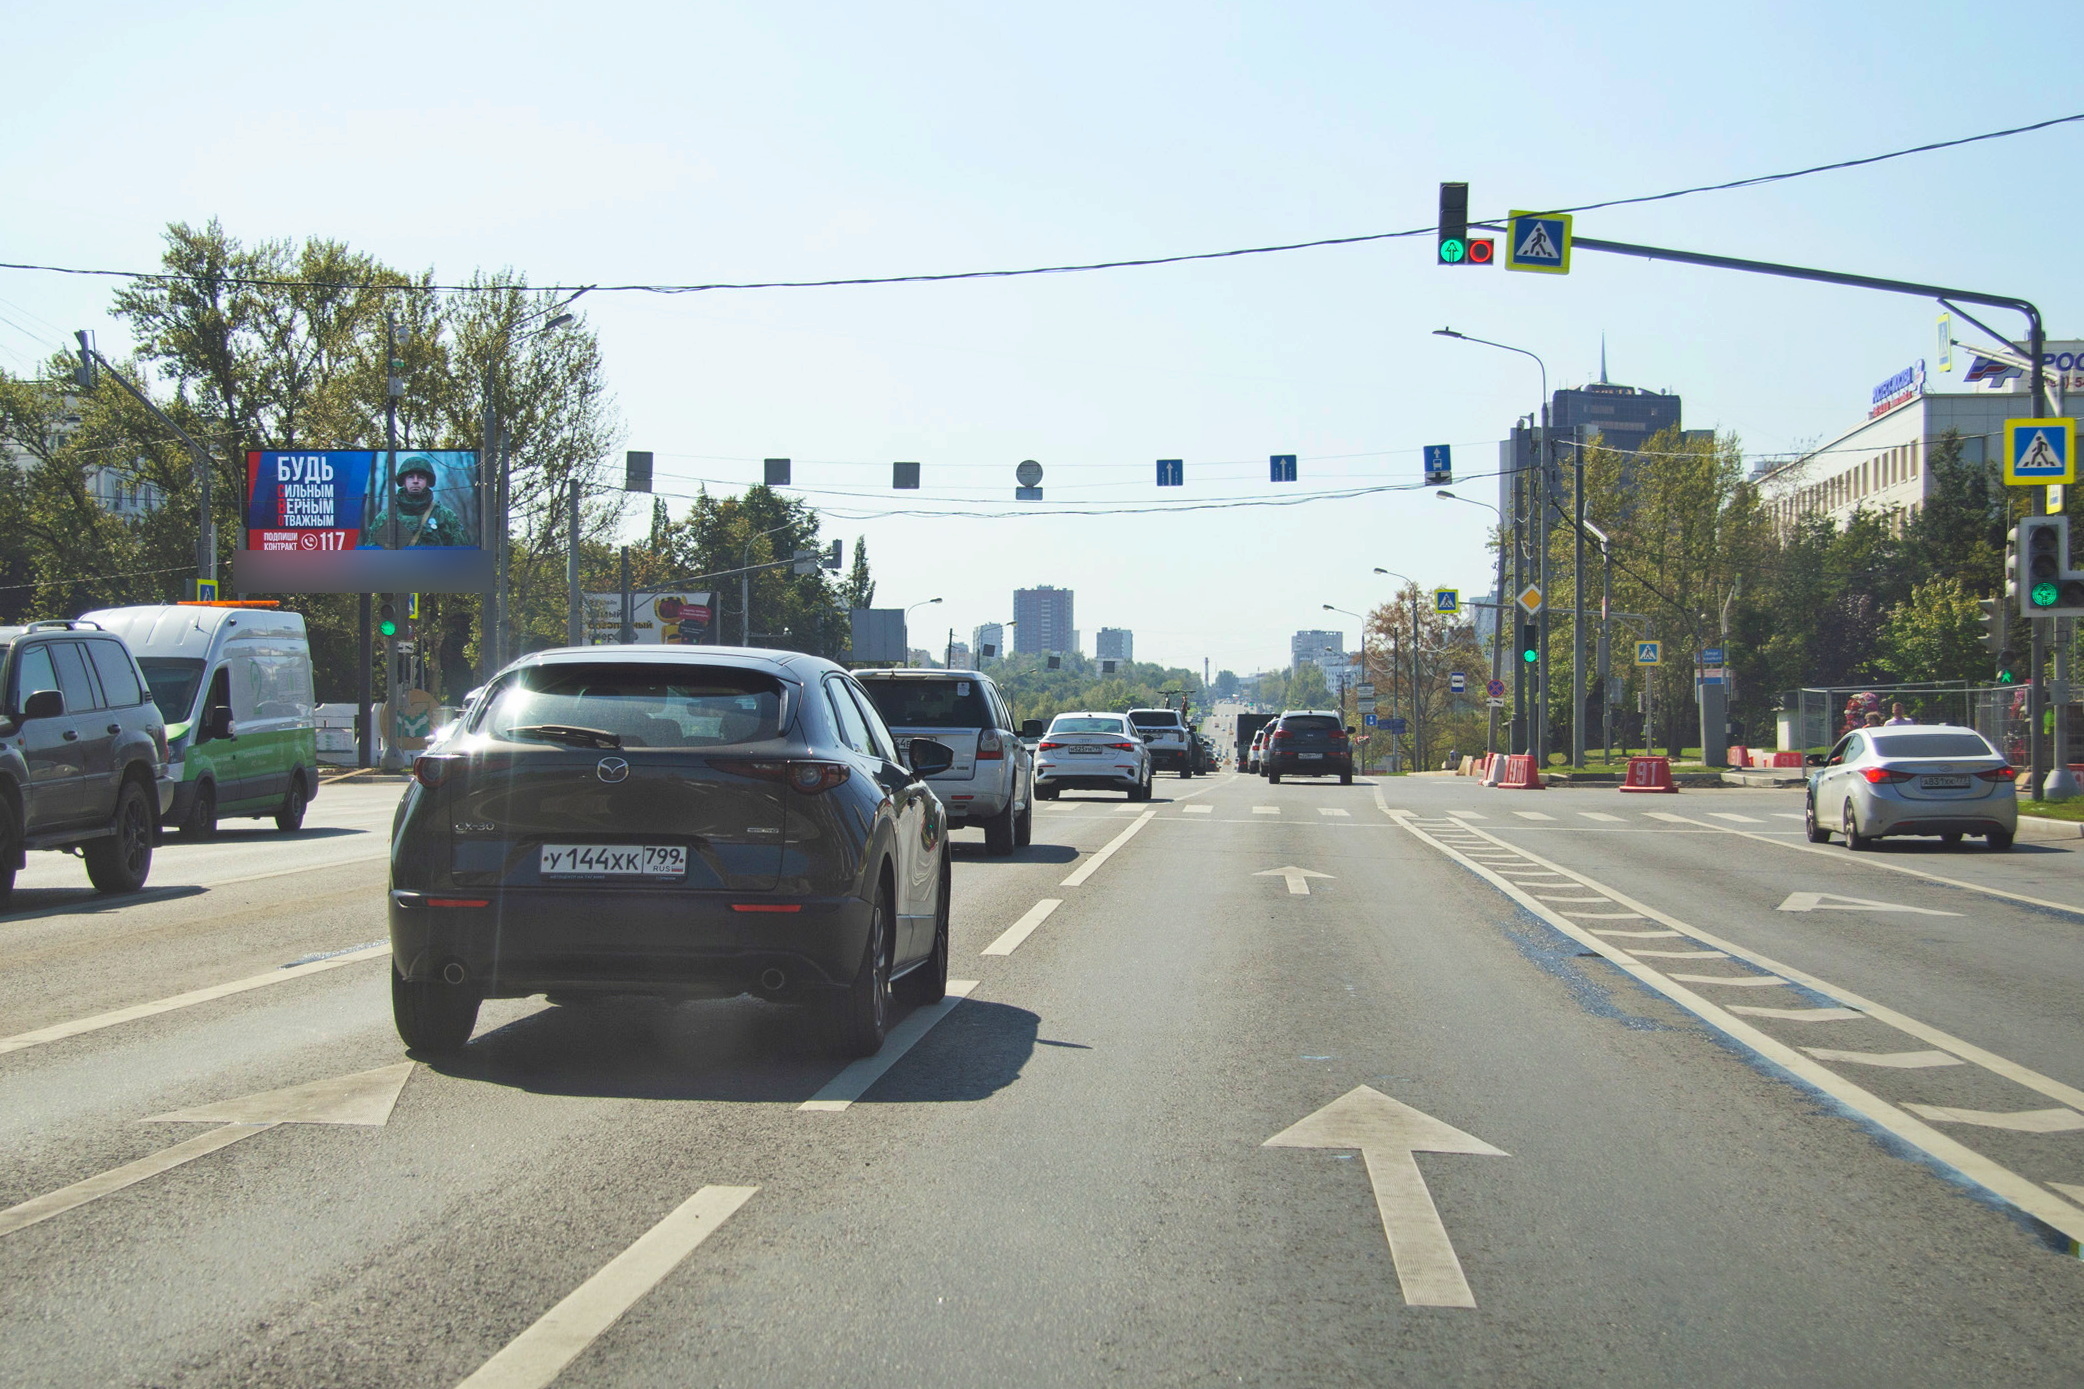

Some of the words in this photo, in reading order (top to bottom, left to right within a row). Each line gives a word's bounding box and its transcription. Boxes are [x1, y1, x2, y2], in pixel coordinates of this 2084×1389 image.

[278, 456, 334, 484] БУДЬ
[278, 484, 334, 498] СИЛЬНЫМ
[278, 498, 334, 514] ВЕРНЫМ
[277, 515, 334, 526] ОТВАЖНЫМ
[264, 532, 298, 541] ПОДПИШИ
[320, 532, 346, 550] 117
[1635, 762, 1657, 785] 91
[550, 848, 640, 870] У144ХК
[646, 848, 681, 865] 799
